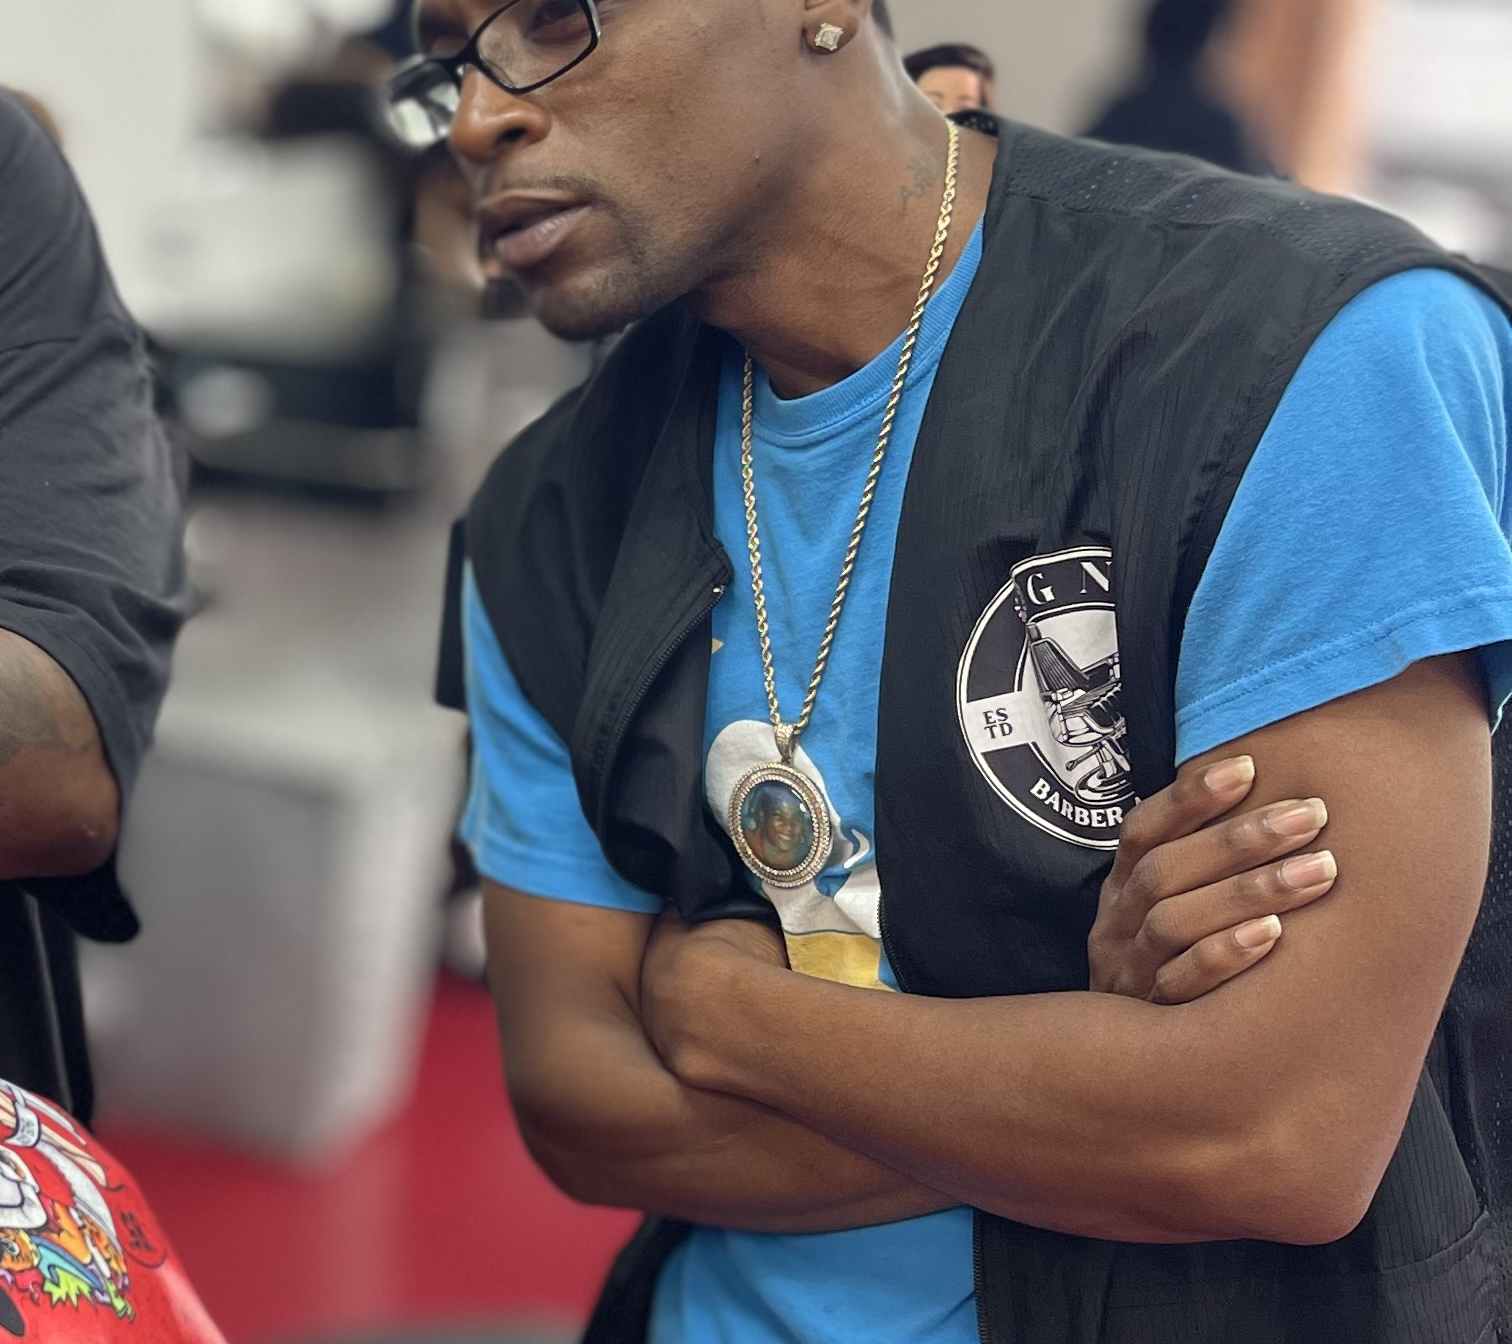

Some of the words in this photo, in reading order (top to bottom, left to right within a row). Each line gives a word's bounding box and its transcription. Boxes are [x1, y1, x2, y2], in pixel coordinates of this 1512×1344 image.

[983, 707, 1009, 725] ES
[984, 722, 1014, 739] TD
[1029, 777, 1124, 828] BARBER
